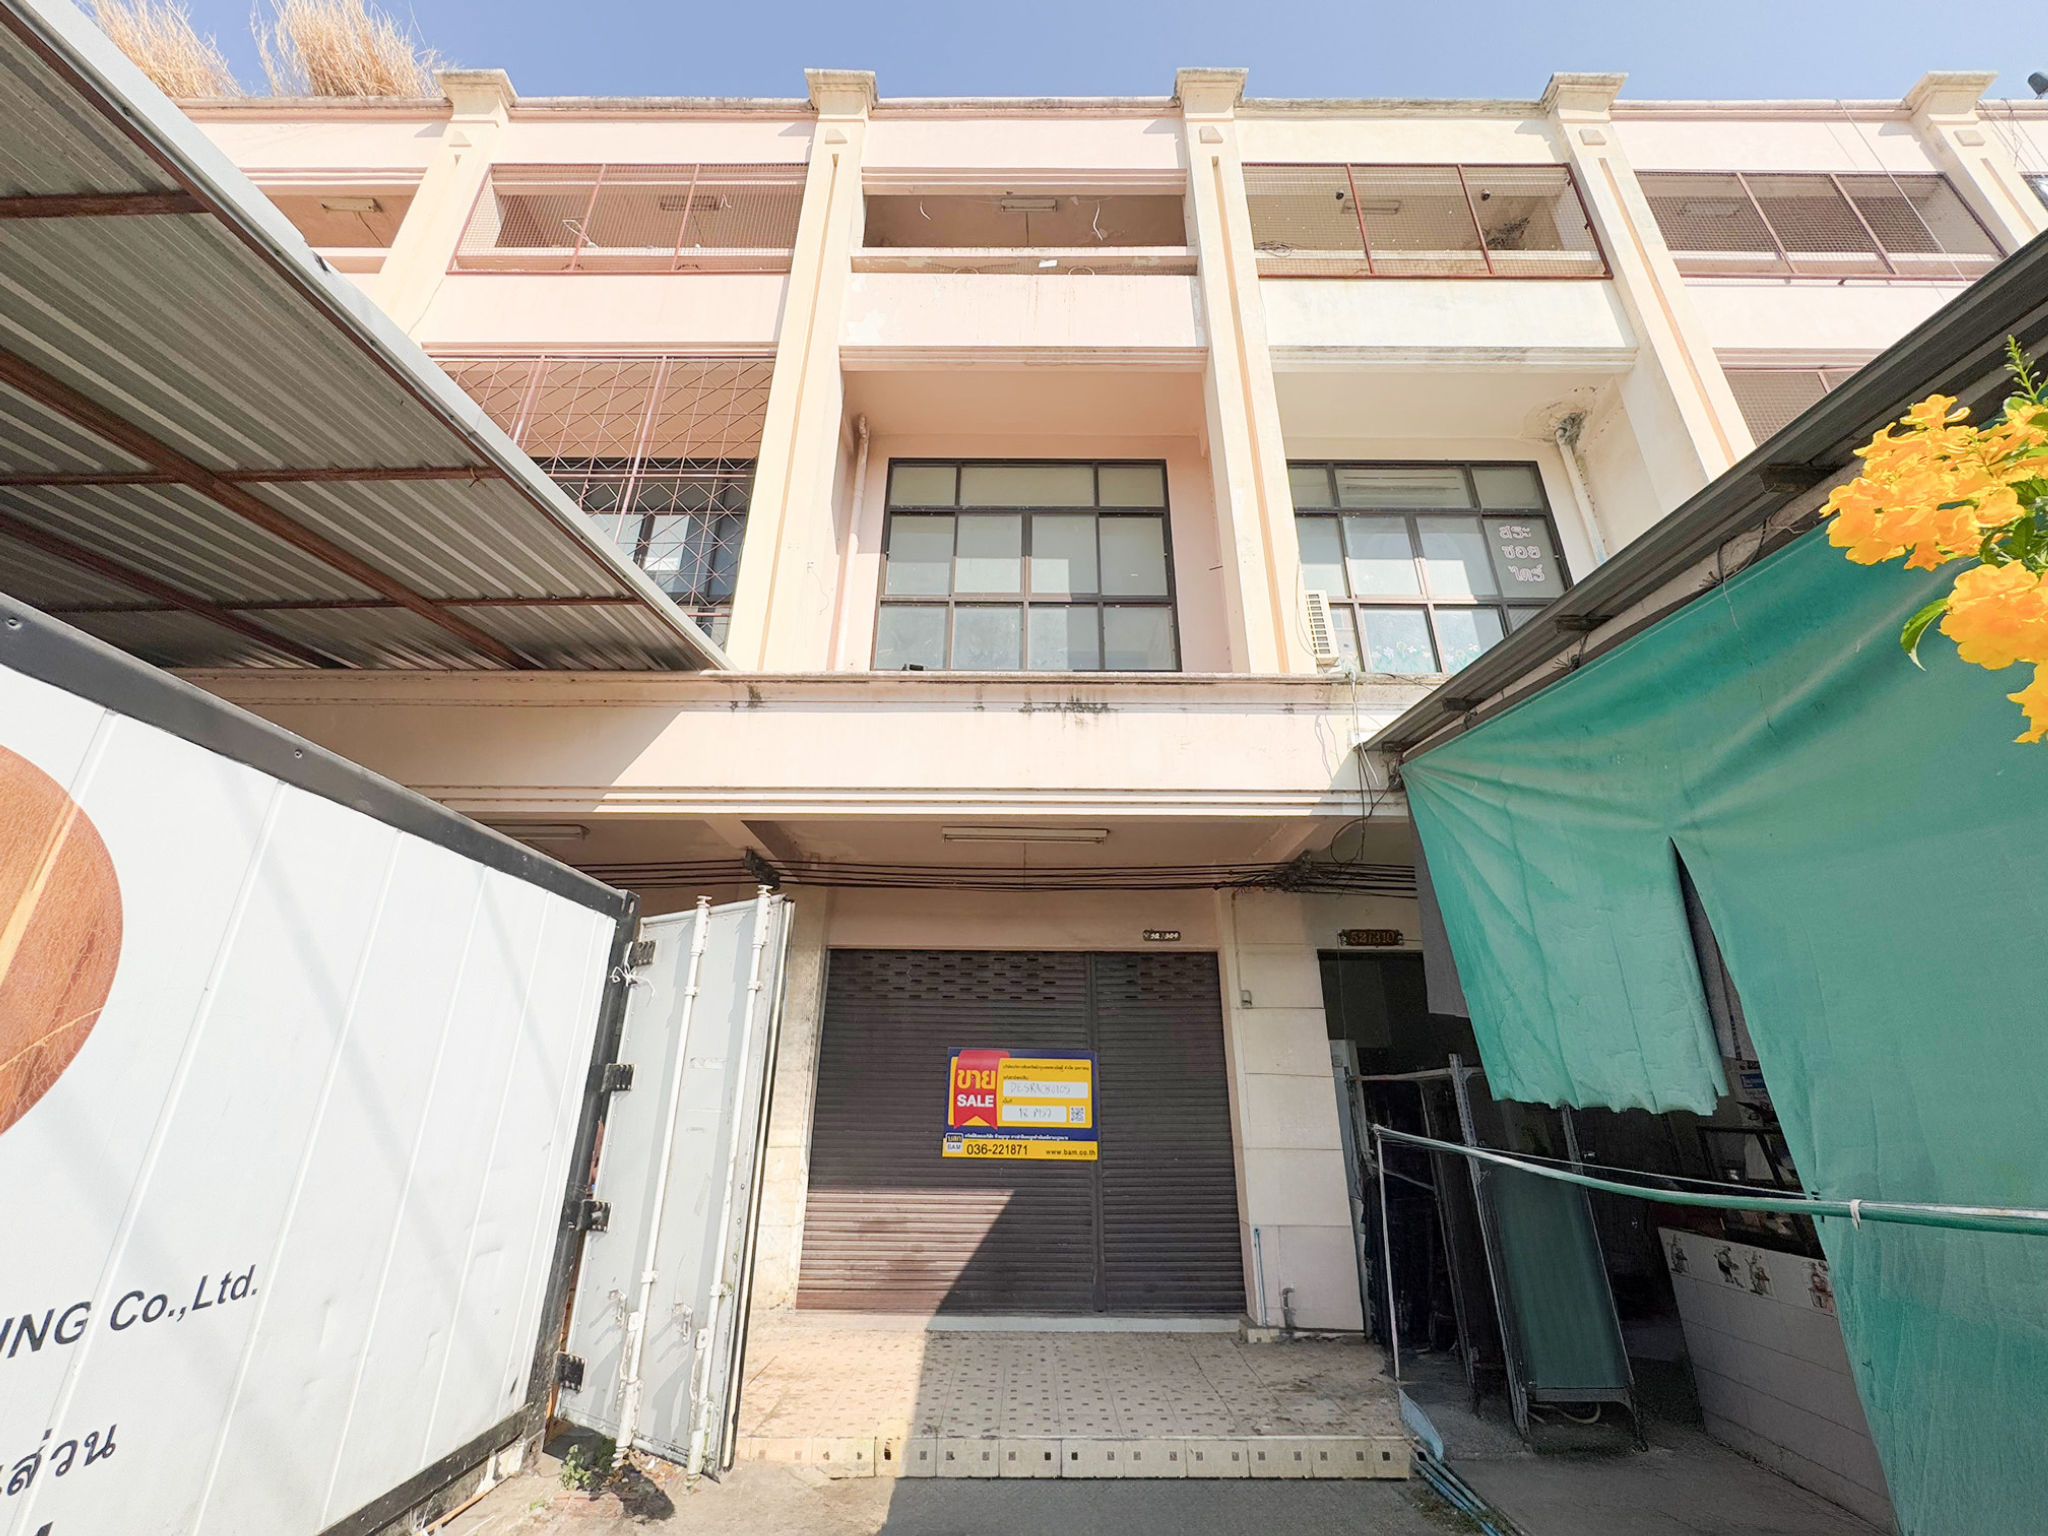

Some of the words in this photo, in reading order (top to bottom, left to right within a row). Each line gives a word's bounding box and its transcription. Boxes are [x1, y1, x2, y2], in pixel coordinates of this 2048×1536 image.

[1499, 525, 1531, 539] สระ
[957, 1069, 996, 1090] ขาย
[957, 1094, 995, 1108] SALE
[966, 1143, 1028, 1156] 036-221871
[1046, 1148, 1096, 1157] www.bam.co.th
[0, 1424, 117, 1496] ส่วน
